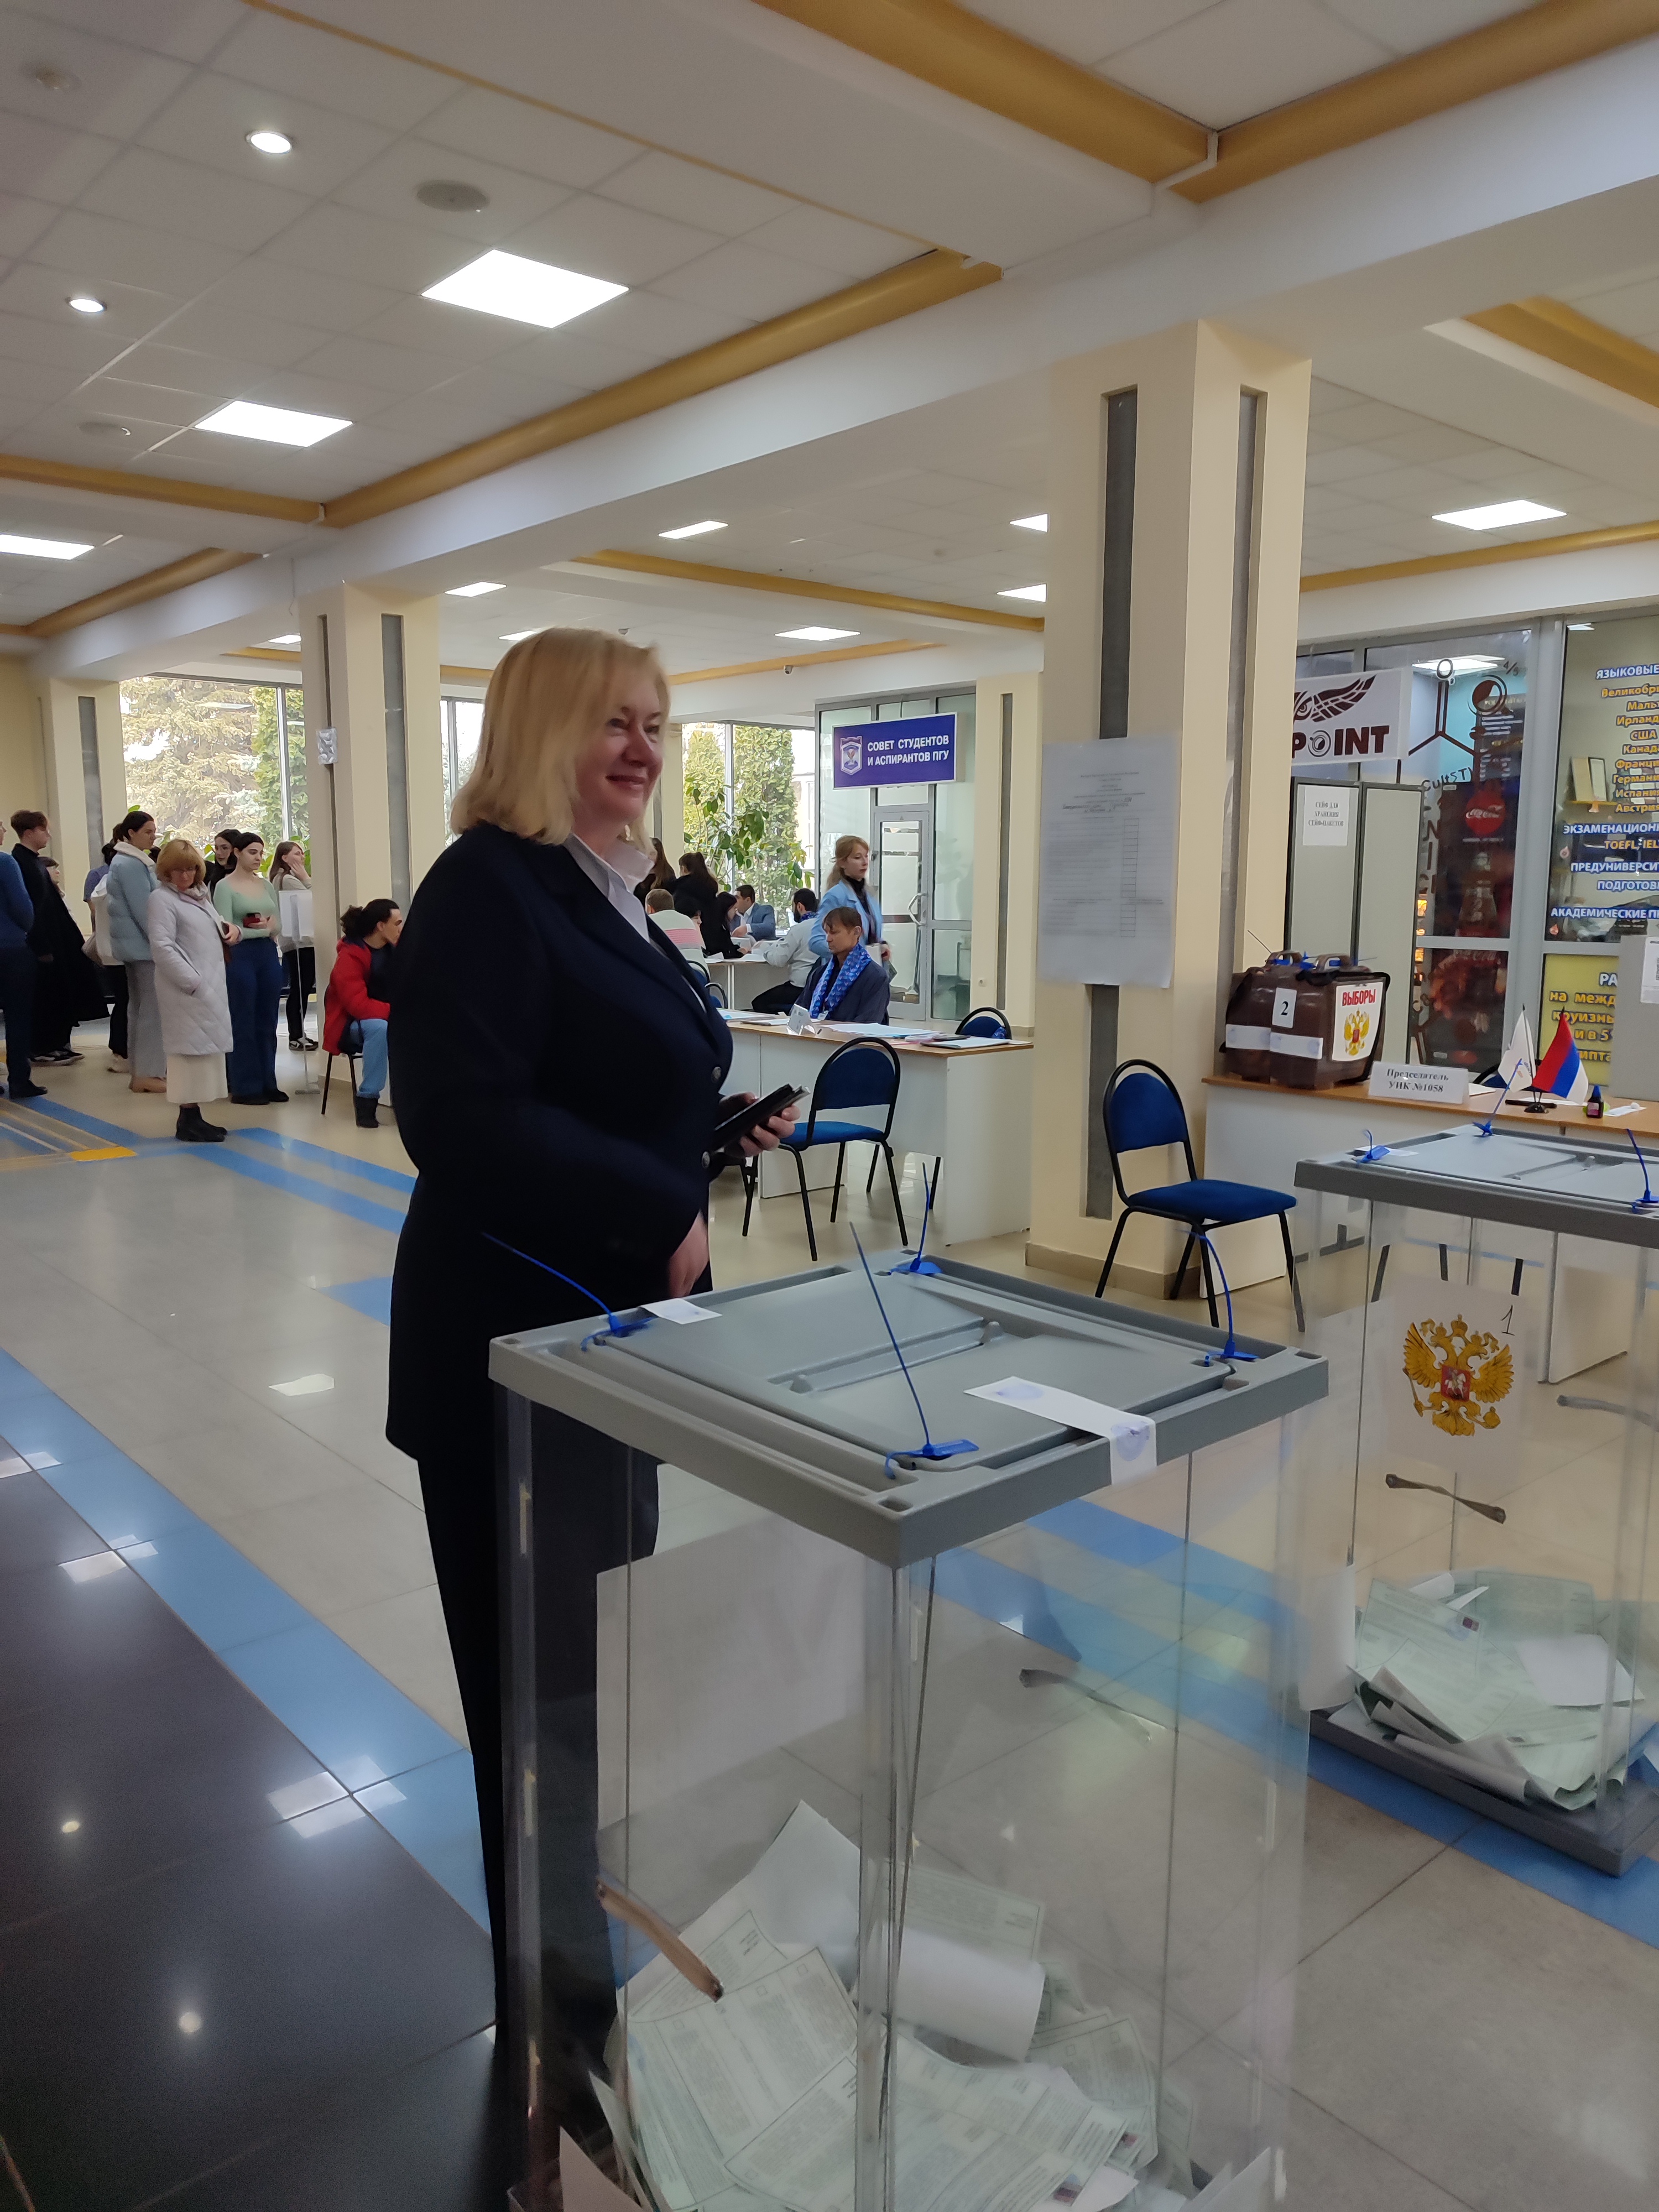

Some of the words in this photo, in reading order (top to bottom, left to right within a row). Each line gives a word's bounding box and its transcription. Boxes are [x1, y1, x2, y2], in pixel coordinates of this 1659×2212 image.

[1596, 665, 1659, 679] ЯЗЫКОВЫЕ
[1631, 730, 1657, 740] США
[867, 740, 895, 752] СОВЕТ
[898, 735, 950, 750] СТУДЕНТОВ
[1624, 745, 1659, 754] Канад
[867, 757, 873, 767] И
[875, 752, 931, 766] АСПИРАНТОВ
[932, 749, 950, 761] ПГУ
[1643, 839, 1659, 849] IEL
[1571, 862, 1659, 873] ПРЕДУНИВЕРСИ
[1598, 881, 1659, 891] ПОДГОТОВ
[1551, 907, 1646, 919] АКАДЕМИЧЕСКИЕ
[1342, 989, 1376, 1006] ВЫБОРЫ
[1550, 992, 1567, 1002] на
[1280, 1000, 1289, 1016] 2
[1575, 1030, 1584, 1040] и
[1588, 1031, 1597, 1040] в
[1386, 1068, 1449, 1081] Председатель
[1412, 1082, 1444, 1093] №1058
